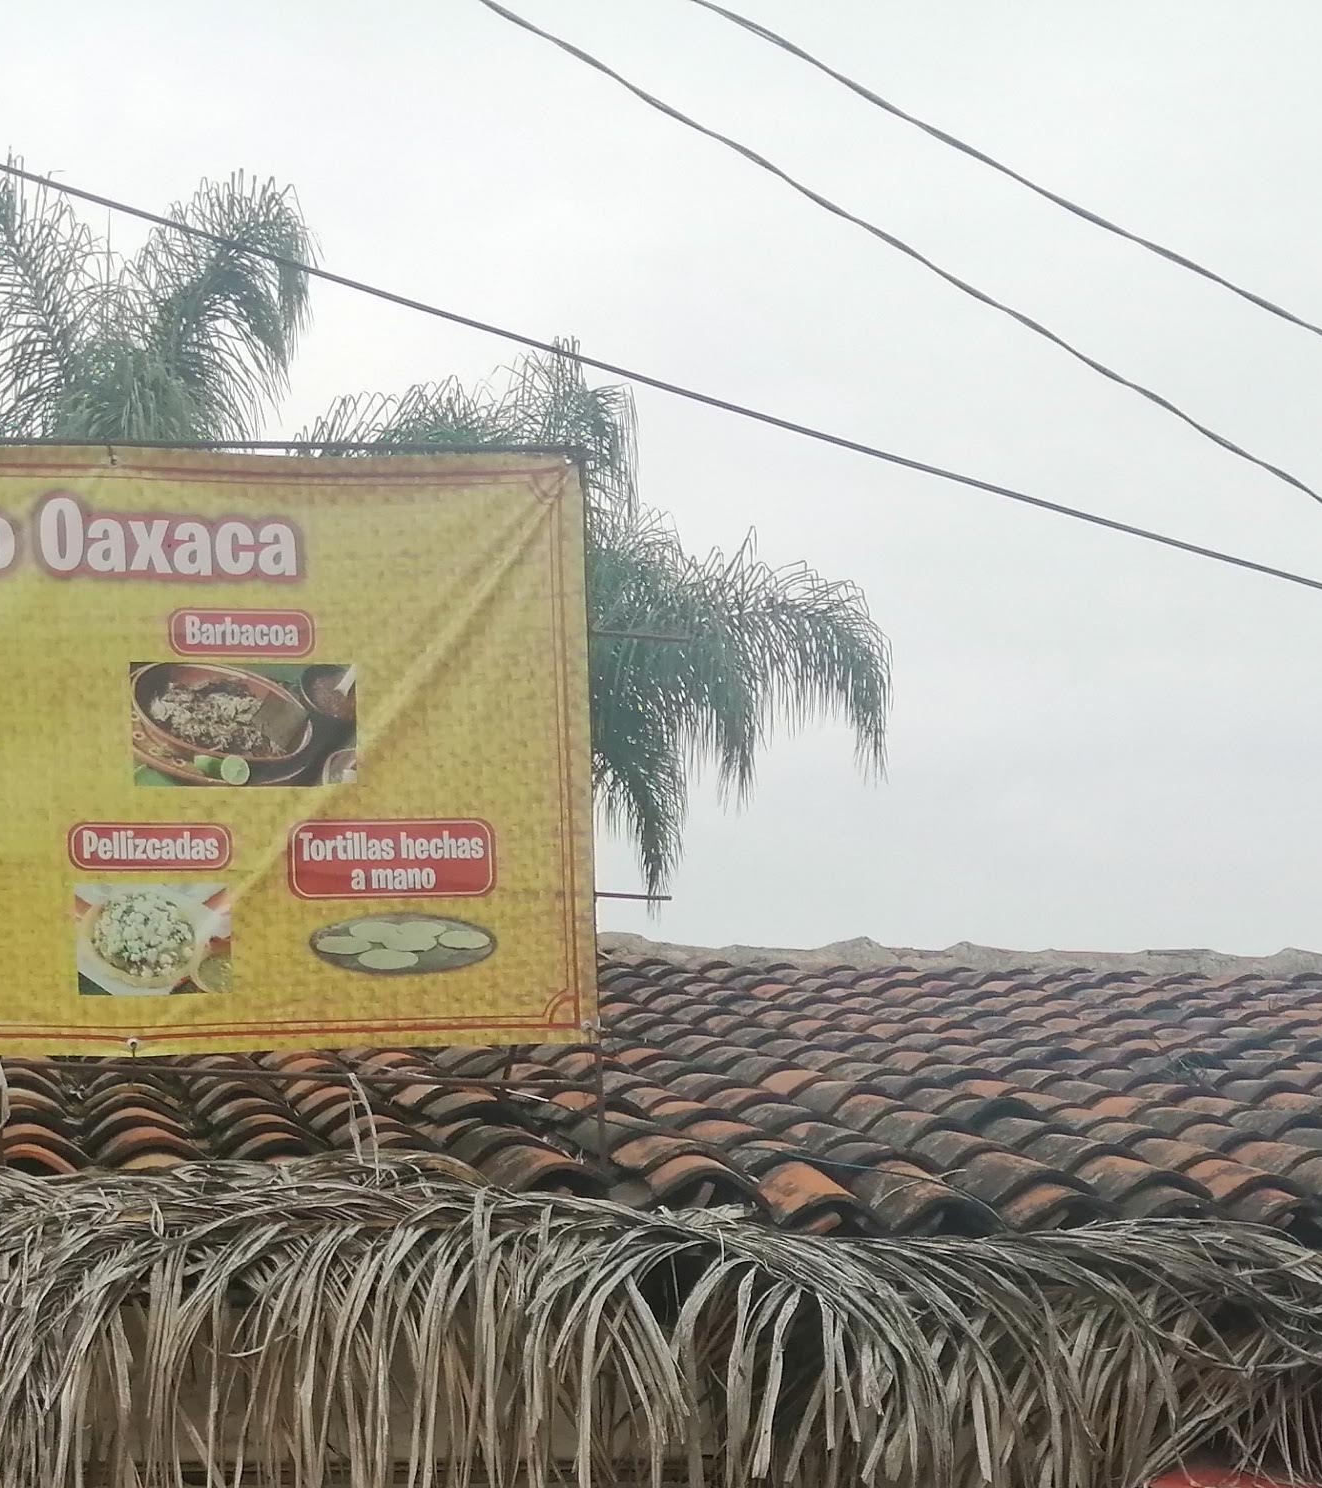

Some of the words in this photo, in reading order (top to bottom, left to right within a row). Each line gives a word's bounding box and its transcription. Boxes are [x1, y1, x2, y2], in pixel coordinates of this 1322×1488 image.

[39, 497, 299, 578] Oaxaca
[184, 616, 301, 648] Barbacoa
[81, 831, 220, 864] Pellizcadas
[300, 830, 394, 862] Tortillas
[399, 830, 485, 860] hechas
[351, 868, 365, 890] a
[370, 867, 436, 889] mano
